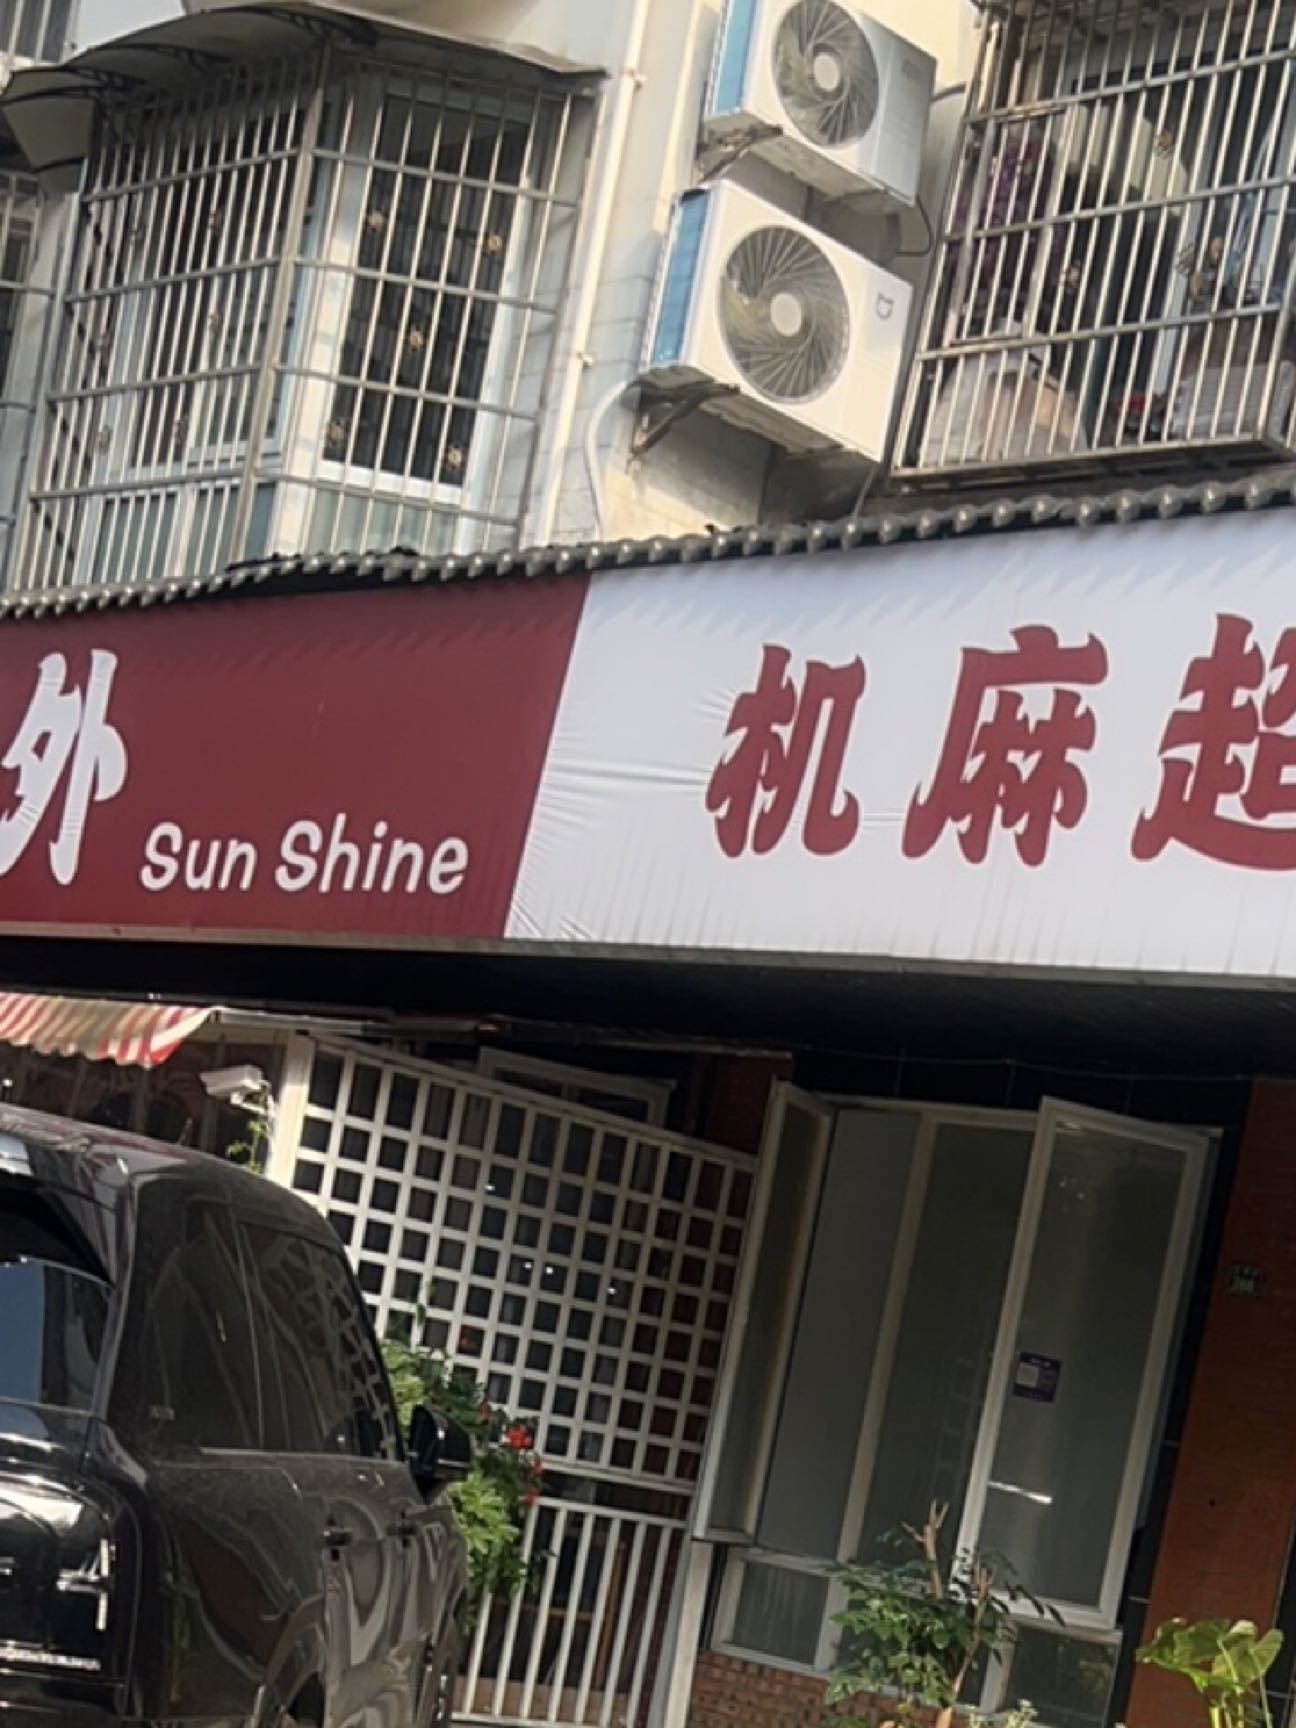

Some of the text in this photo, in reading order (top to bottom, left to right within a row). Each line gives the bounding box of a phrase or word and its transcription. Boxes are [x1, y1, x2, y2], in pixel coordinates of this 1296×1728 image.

[0, 649, 129, 886] 外
[140, 812, 470, 895] Sun Shine
